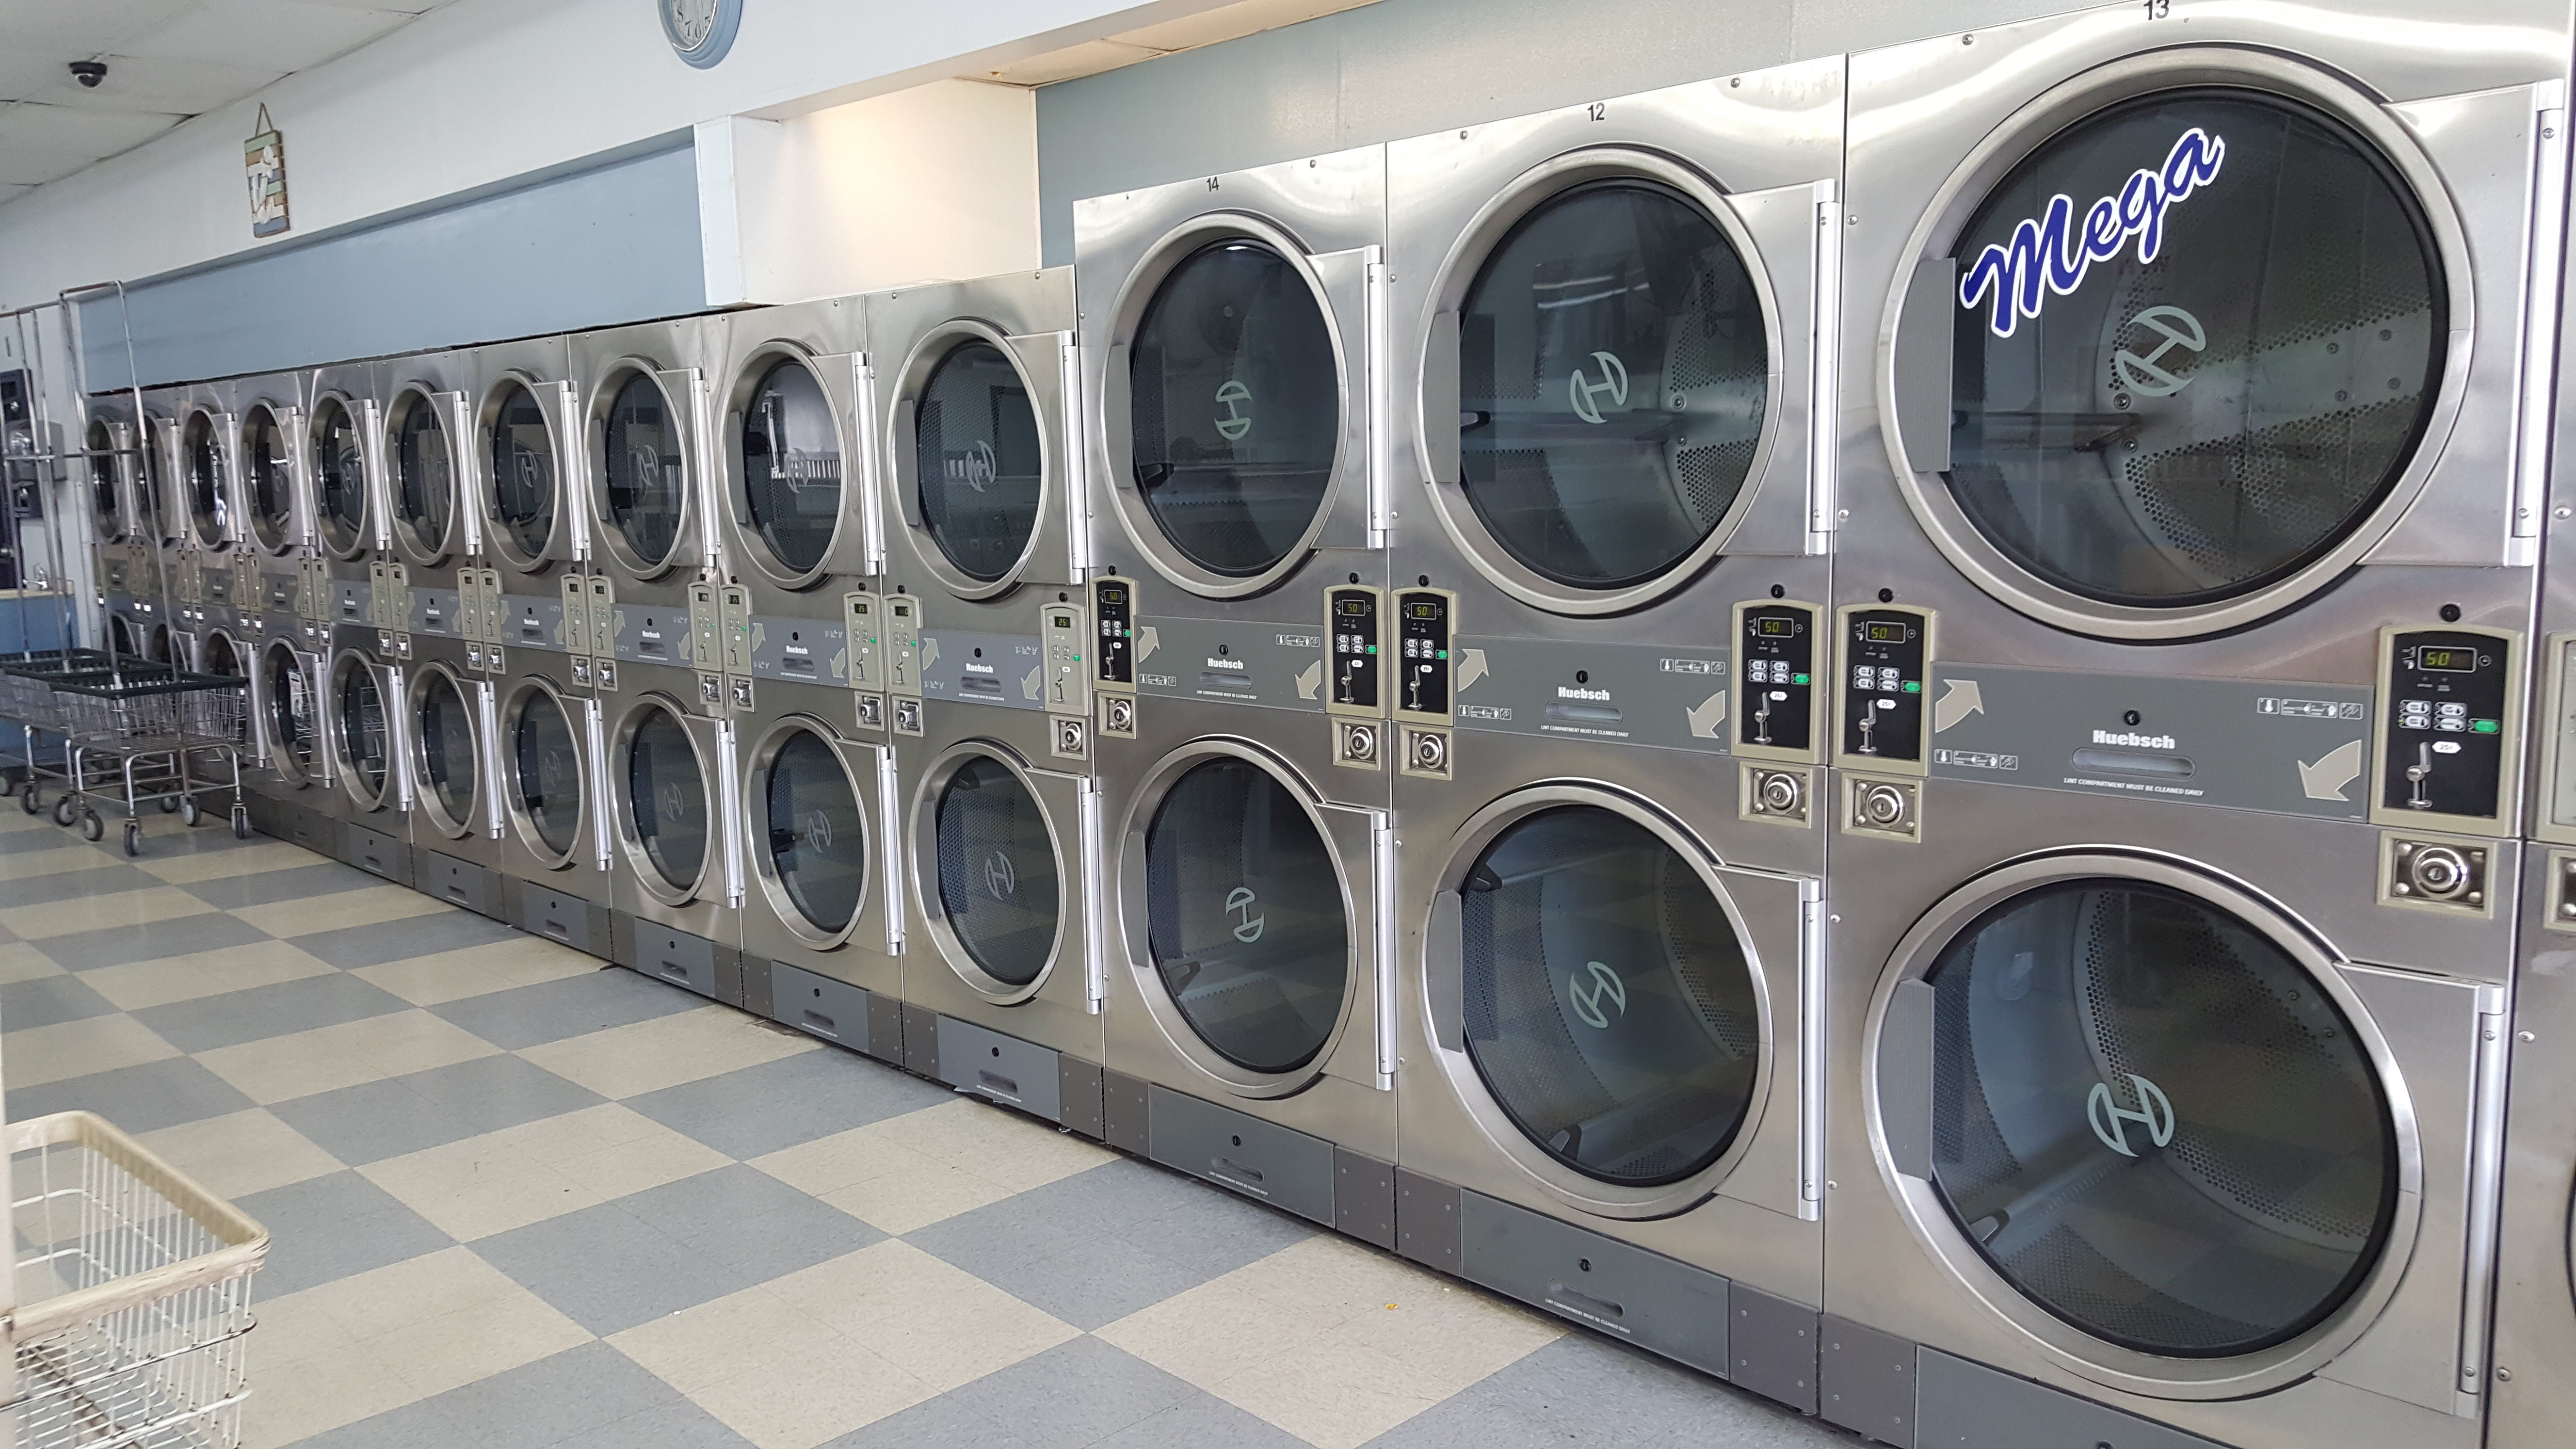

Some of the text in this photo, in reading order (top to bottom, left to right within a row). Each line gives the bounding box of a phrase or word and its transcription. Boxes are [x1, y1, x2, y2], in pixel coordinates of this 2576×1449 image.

[2143, 0, 2169, 20] 13
[1587, 102, 1605, 122] 12
[1207, 177, 1220, 192] 14
[1959, 128, 2226, 338] Mega
[1348, 603, 1357, 612] 50
[1417, 606, 1427, 616] 50
[1765, 622, 1780, 632] 50
[1871, 628, 1888, 639] 50
[1208, 658, 1243, 669] Huebsch
[2426, 652, 2451, 666] 50
[966, 663, 994, 673] Huebsch
[1558, 686, 1610, 701] Huebsch
[2093, 729, 2176, 749] Huebsch
